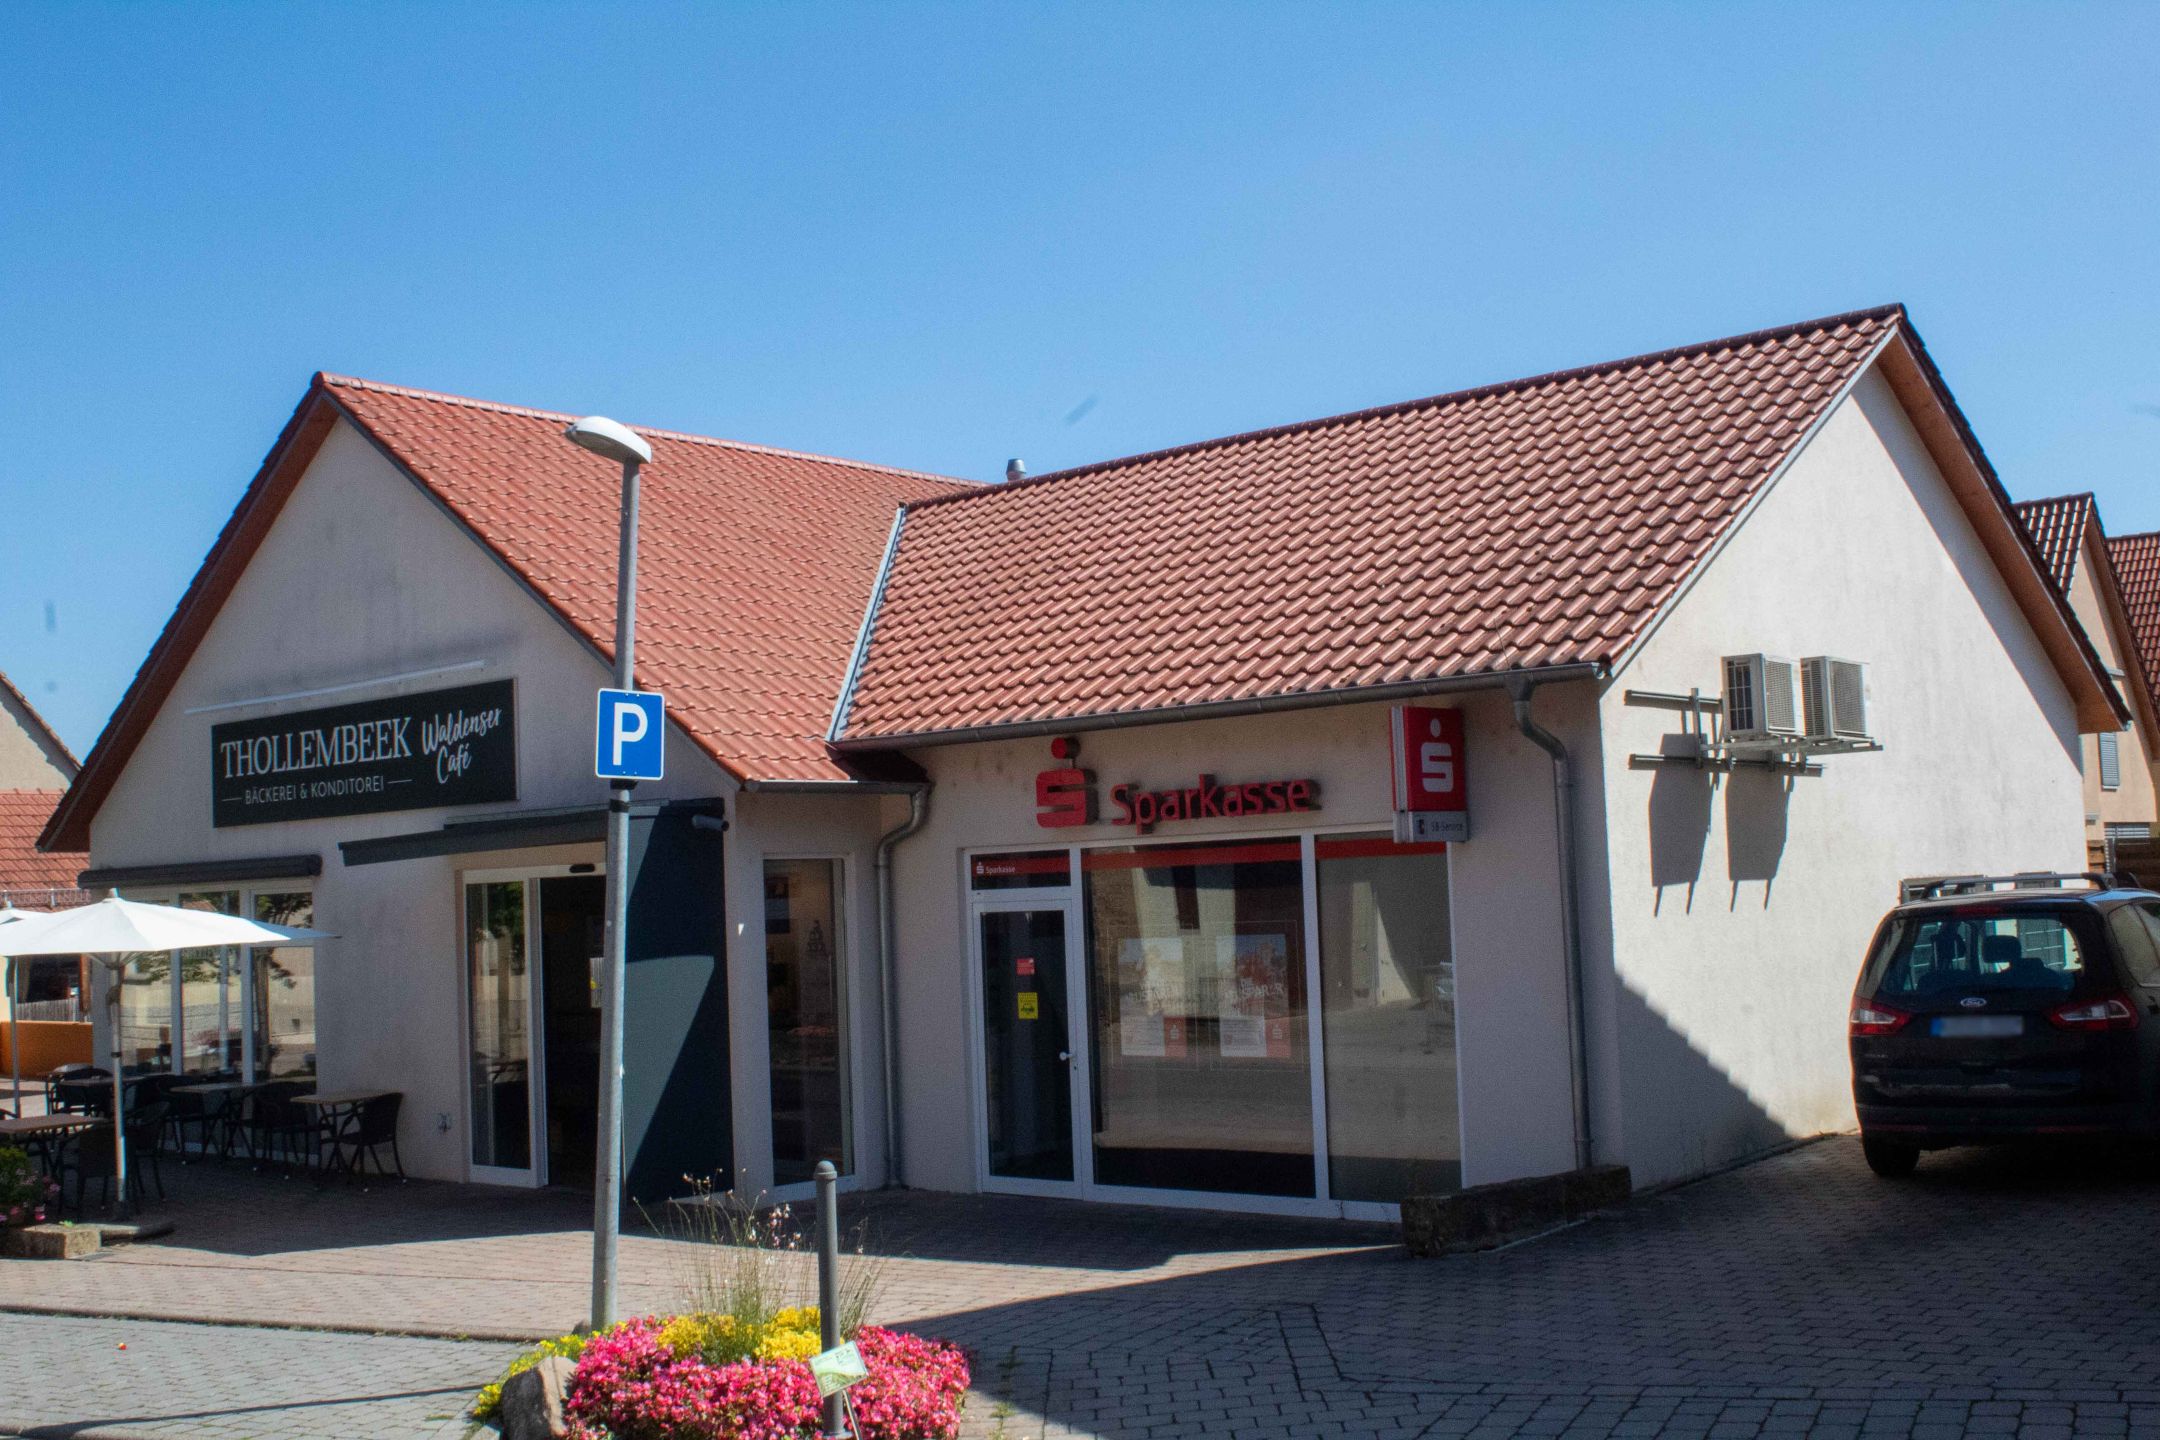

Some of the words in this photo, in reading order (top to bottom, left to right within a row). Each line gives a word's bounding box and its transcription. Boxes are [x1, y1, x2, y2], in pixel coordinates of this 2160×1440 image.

[220, 716, 412, 779] THOLLEMBEEK
[422, 708, 502, 755] Waldenser
[613, 702, 648, 766] P
[244, 784, 297, 805] BÄCKEREI
[300, 782, 308, 799] &
[311, 775, 385, 798] KONDITOREI
[437, 743, 472, 784] Café
[1109, 773, 1312, 835] Sparkasse
